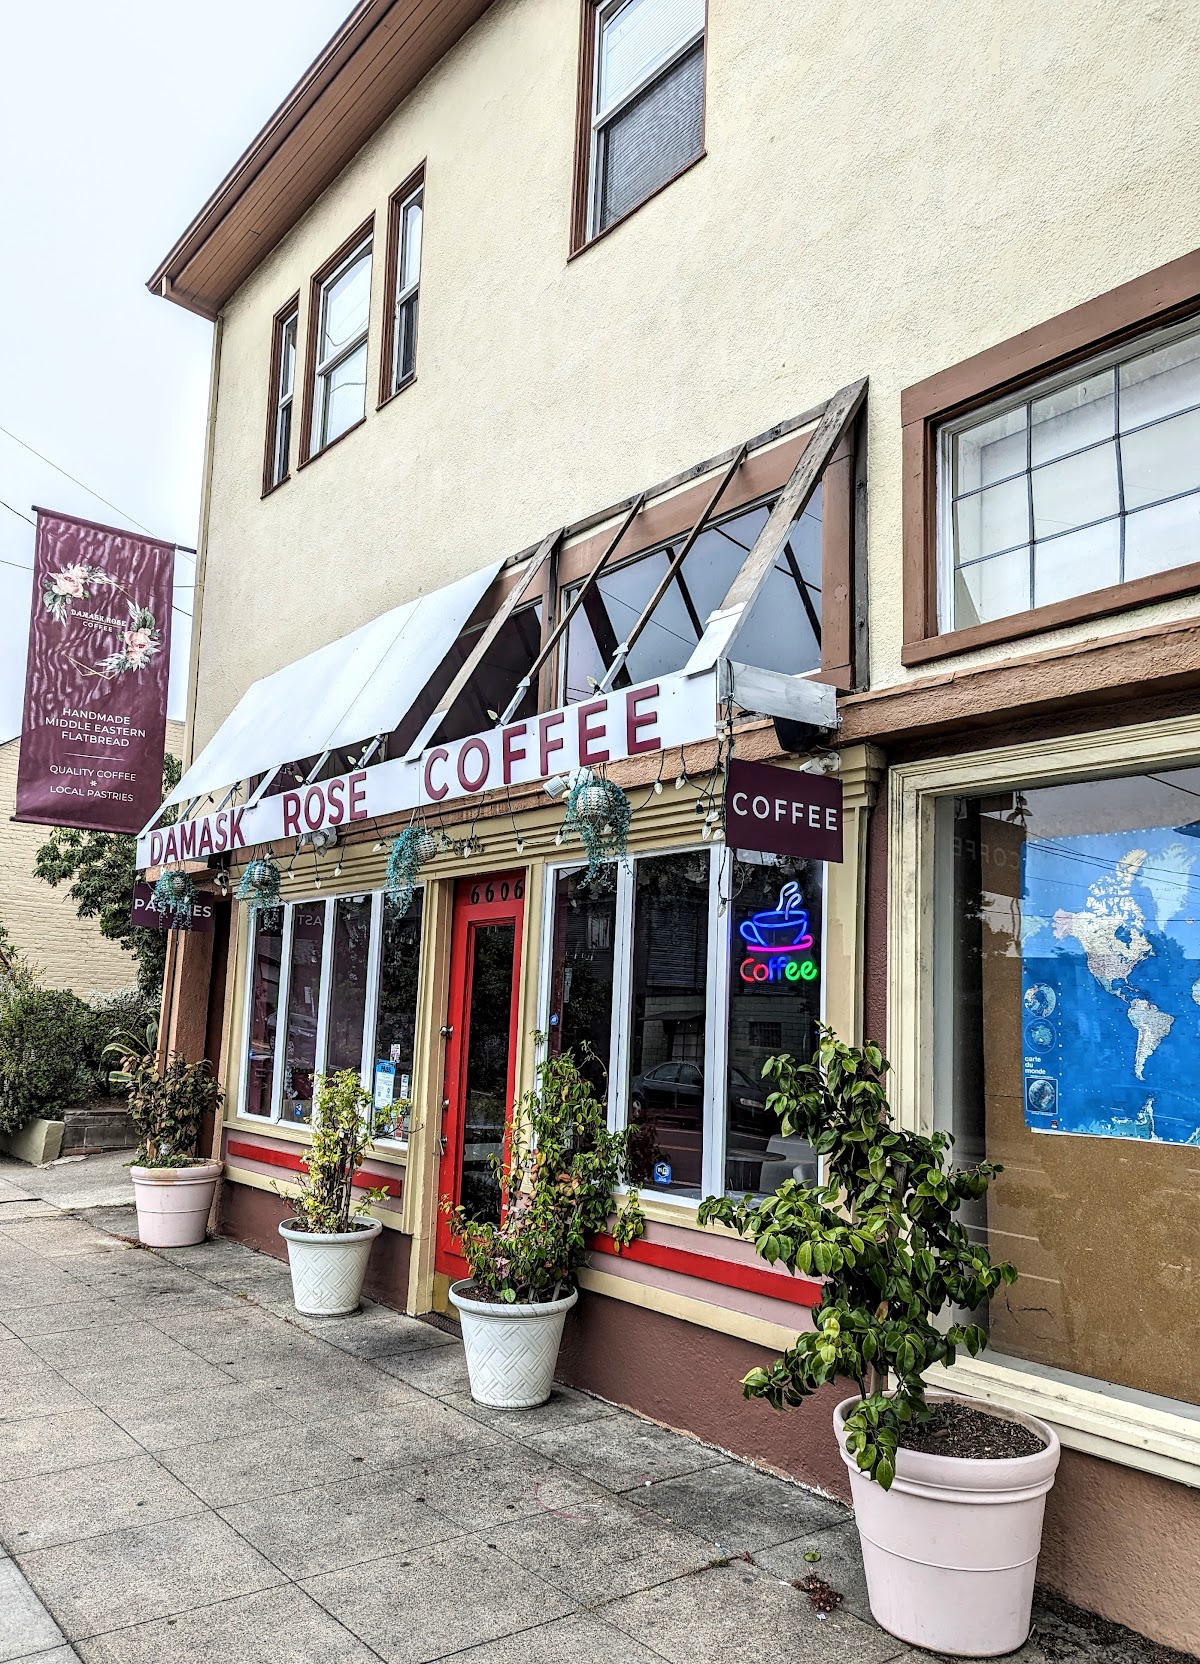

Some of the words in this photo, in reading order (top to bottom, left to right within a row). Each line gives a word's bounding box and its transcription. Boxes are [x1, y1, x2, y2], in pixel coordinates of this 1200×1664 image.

[82, 620, 113, 633] COFFEE
[62, 707, 131, 725] HANDMADE
[45, 717, 91, 731] MIDDLE
[94, 724, 146, 738] EASTERN
[61, 731, 130, 747] FLATBREAD
[49, 764, 95, 777] QUALITY
[96, 769, 137, 782] COFFEE
[149, 807, 247, 867] DAMASK
[282, 771, 369, 837] ROSE
[424, 684, 661, 800] COFFEE
[49, 785, 84, 797] LOCAL
[87, 789, 134, 802] PASTRIES
[732, 792, 837, 831] COFFEE
[470, 879, 524, 905] 6606
[739, 956, 818, 983] Coffee
